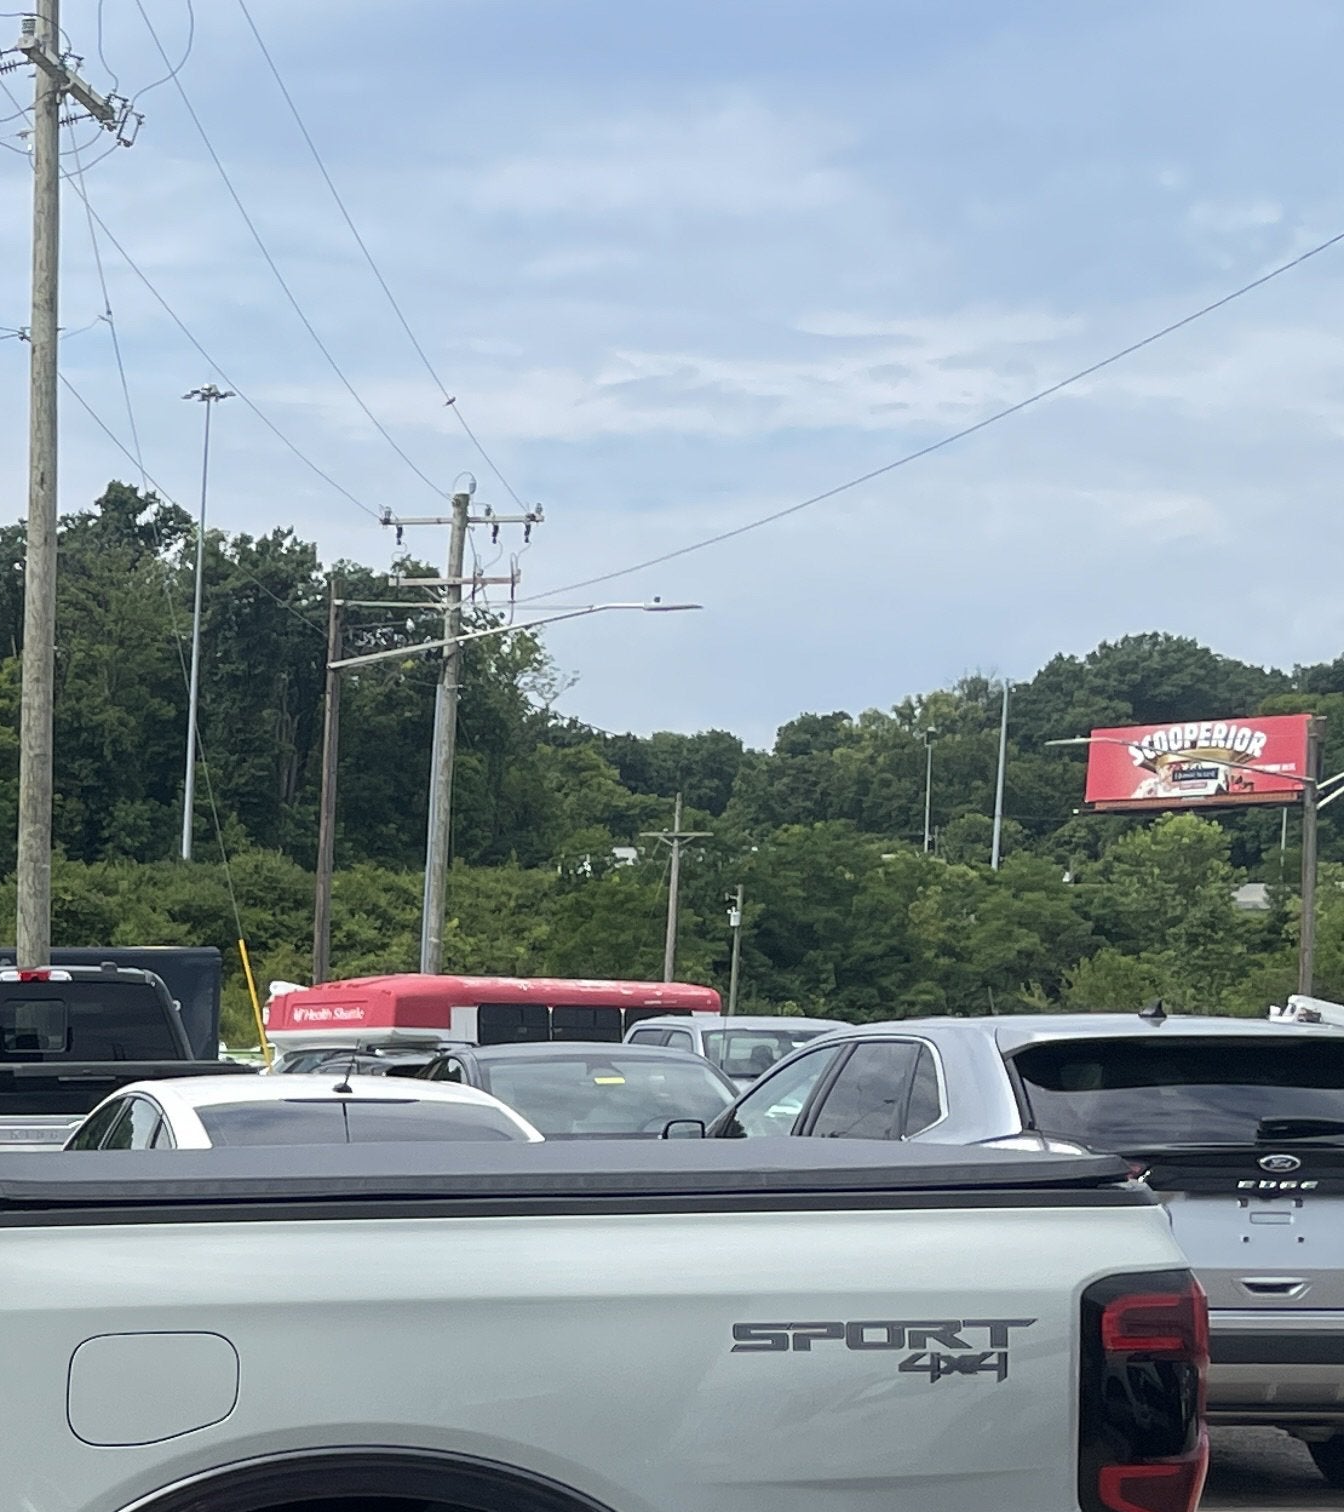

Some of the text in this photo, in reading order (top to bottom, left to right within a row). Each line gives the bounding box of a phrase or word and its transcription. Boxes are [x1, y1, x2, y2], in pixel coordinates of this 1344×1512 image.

[1128, 722, 1267, 767] SCOOPERIOR
[1237, 1180, 1319, 1189] EDGE
[730, 1318, 1038, 1352] SPORT
